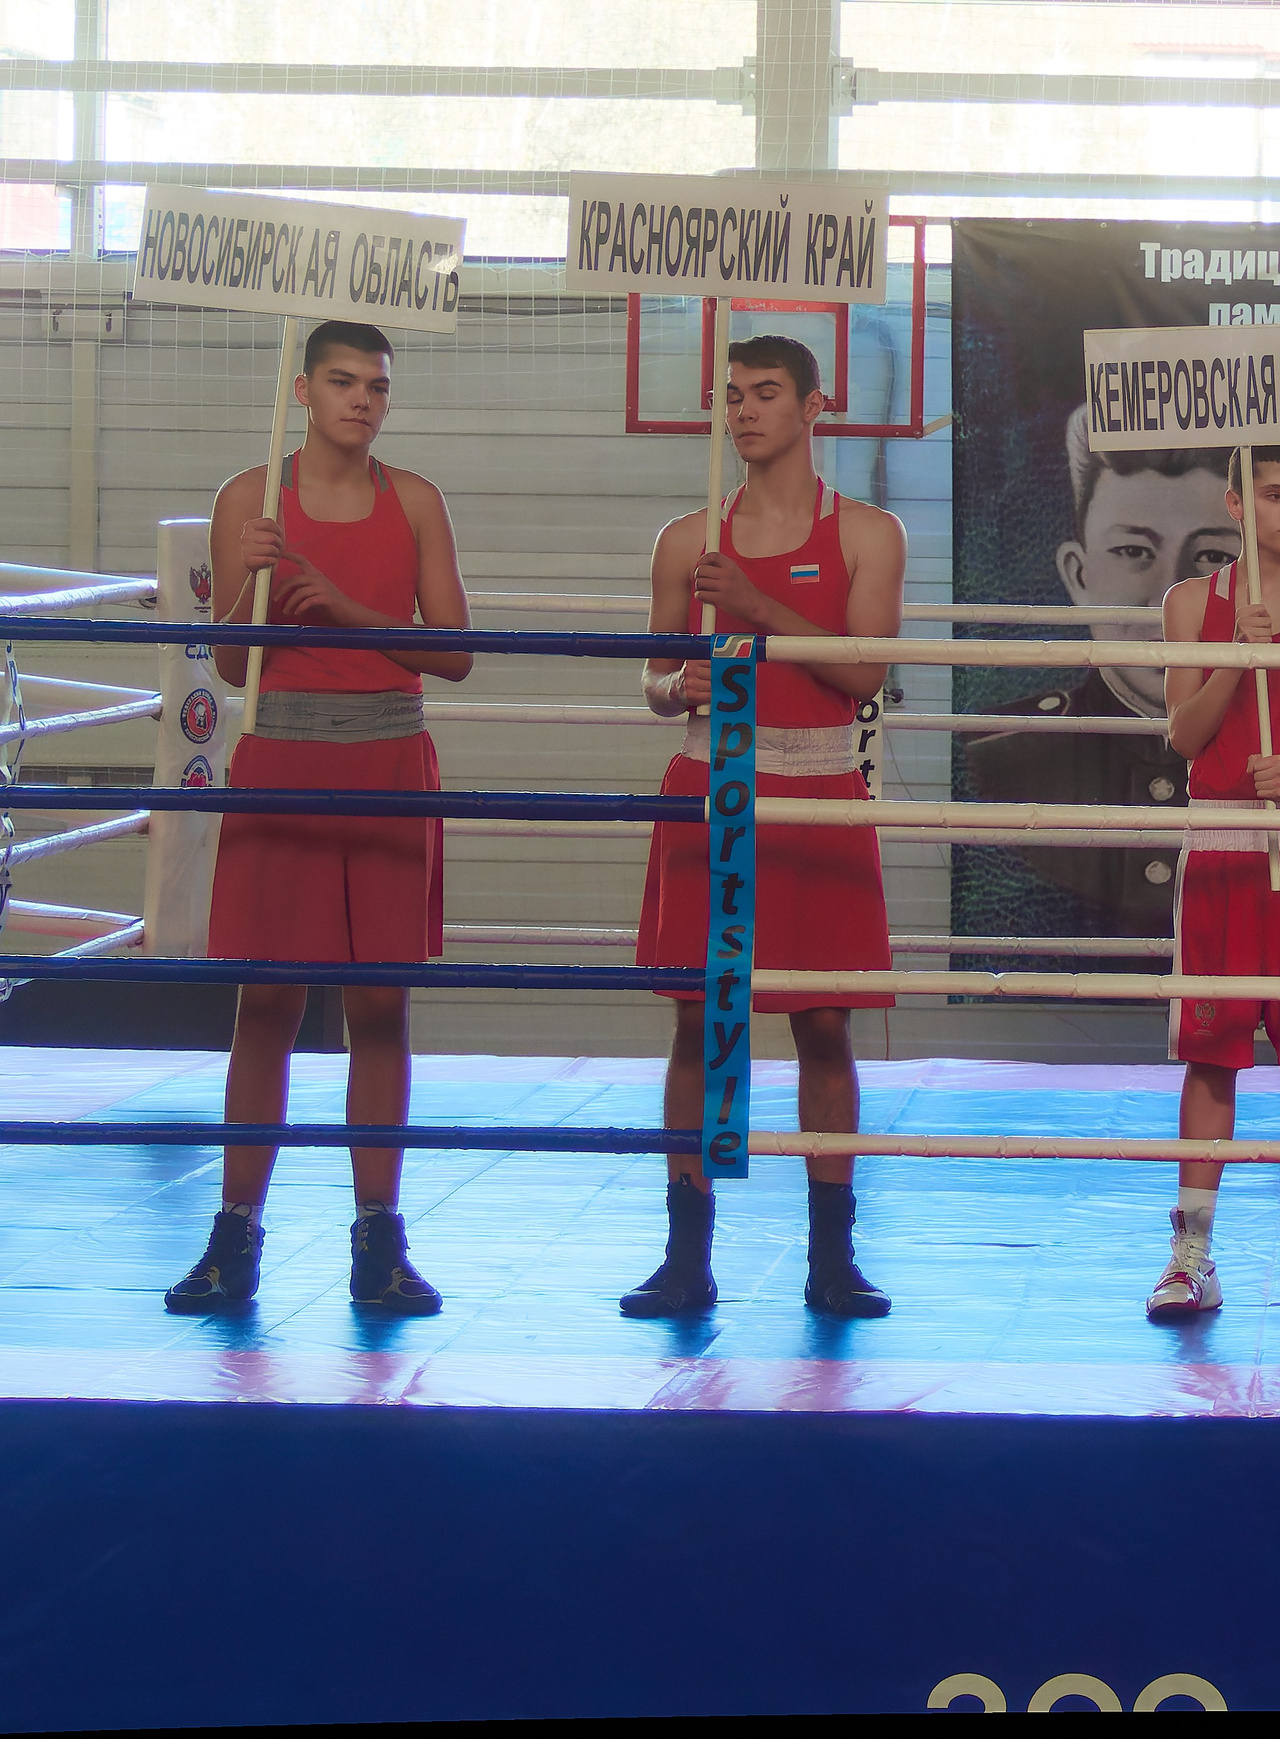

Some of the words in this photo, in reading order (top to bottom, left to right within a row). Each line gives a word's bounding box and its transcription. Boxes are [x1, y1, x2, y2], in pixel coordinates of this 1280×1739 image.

[350, 233, 460, 312] ОБЛАСТЬ
[578, 194, 791, 283] КРАСНОЯРСКИЙ
[804, 200, 876, 288] КРАЙ
[1089, 355, 1278, 433] КЕМЕРОВСКАЯ
[708, 664, 753, 1165] Sportstyle
